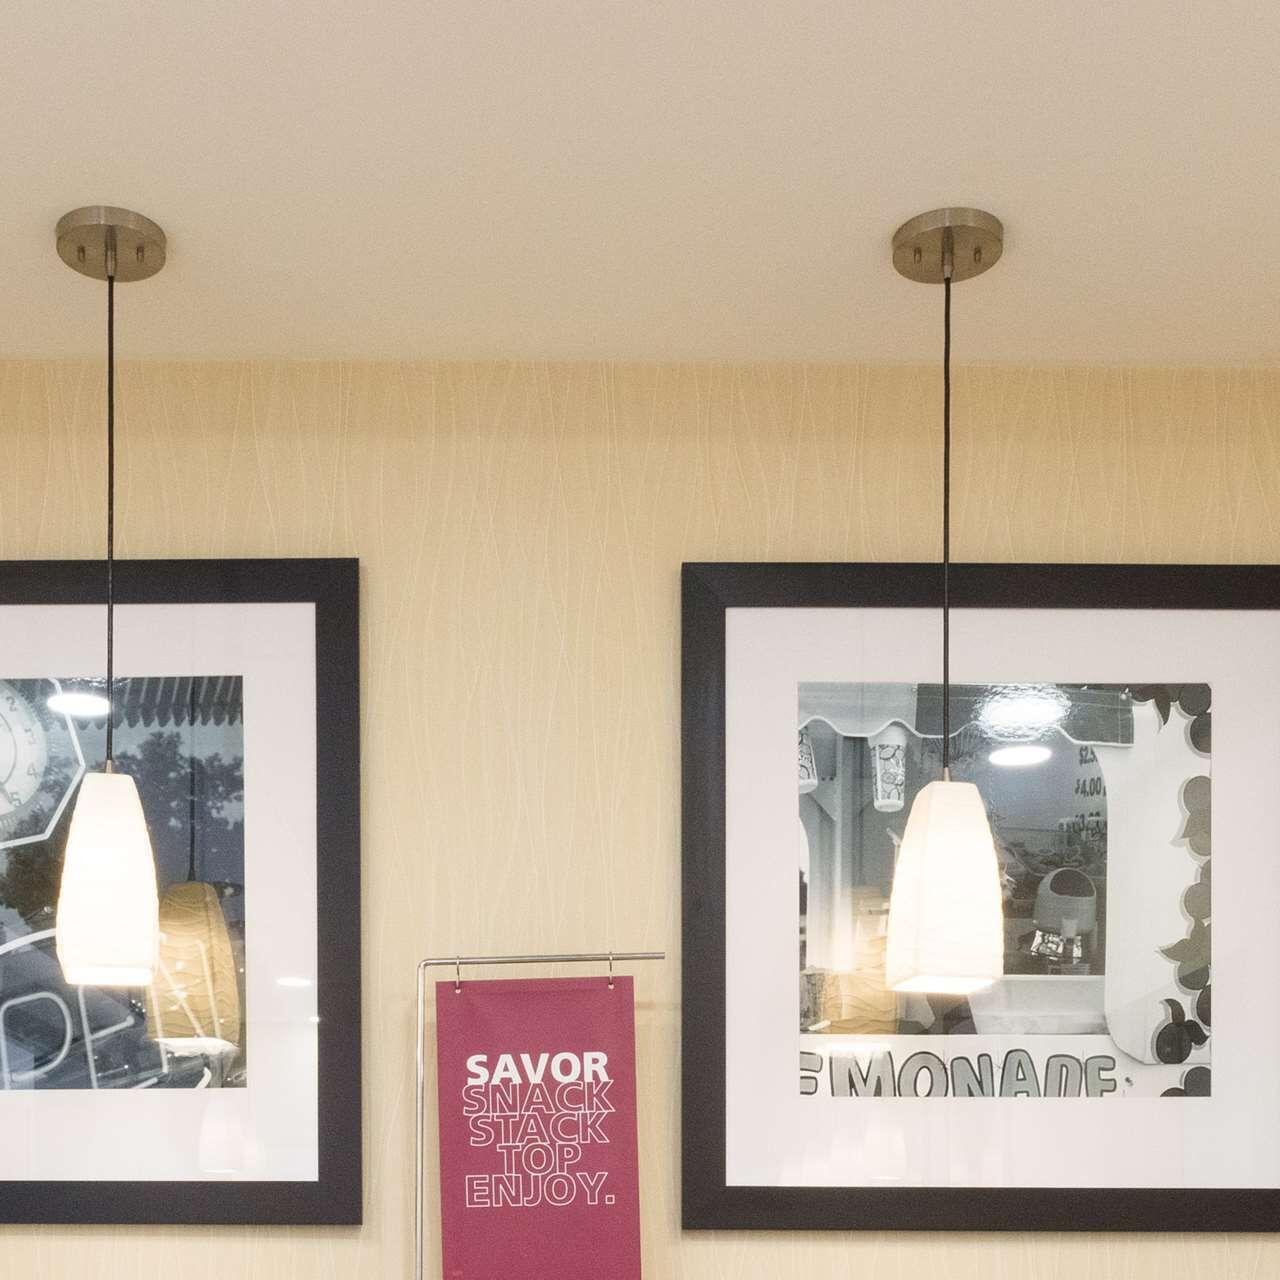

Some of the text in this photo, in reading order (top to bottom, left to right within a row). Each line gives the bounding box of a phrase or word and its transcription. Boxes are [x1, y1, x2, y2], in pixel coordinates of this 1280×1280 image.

[466, 1052, 609, 1085] SAVOR
[462, 1080, 616, 1116] SNACK
[469, 1111, 610, 1146] STACK
[496, 1142, 582, 1176] TOP
[465, 1172, 615, 1208] ENJOY.
